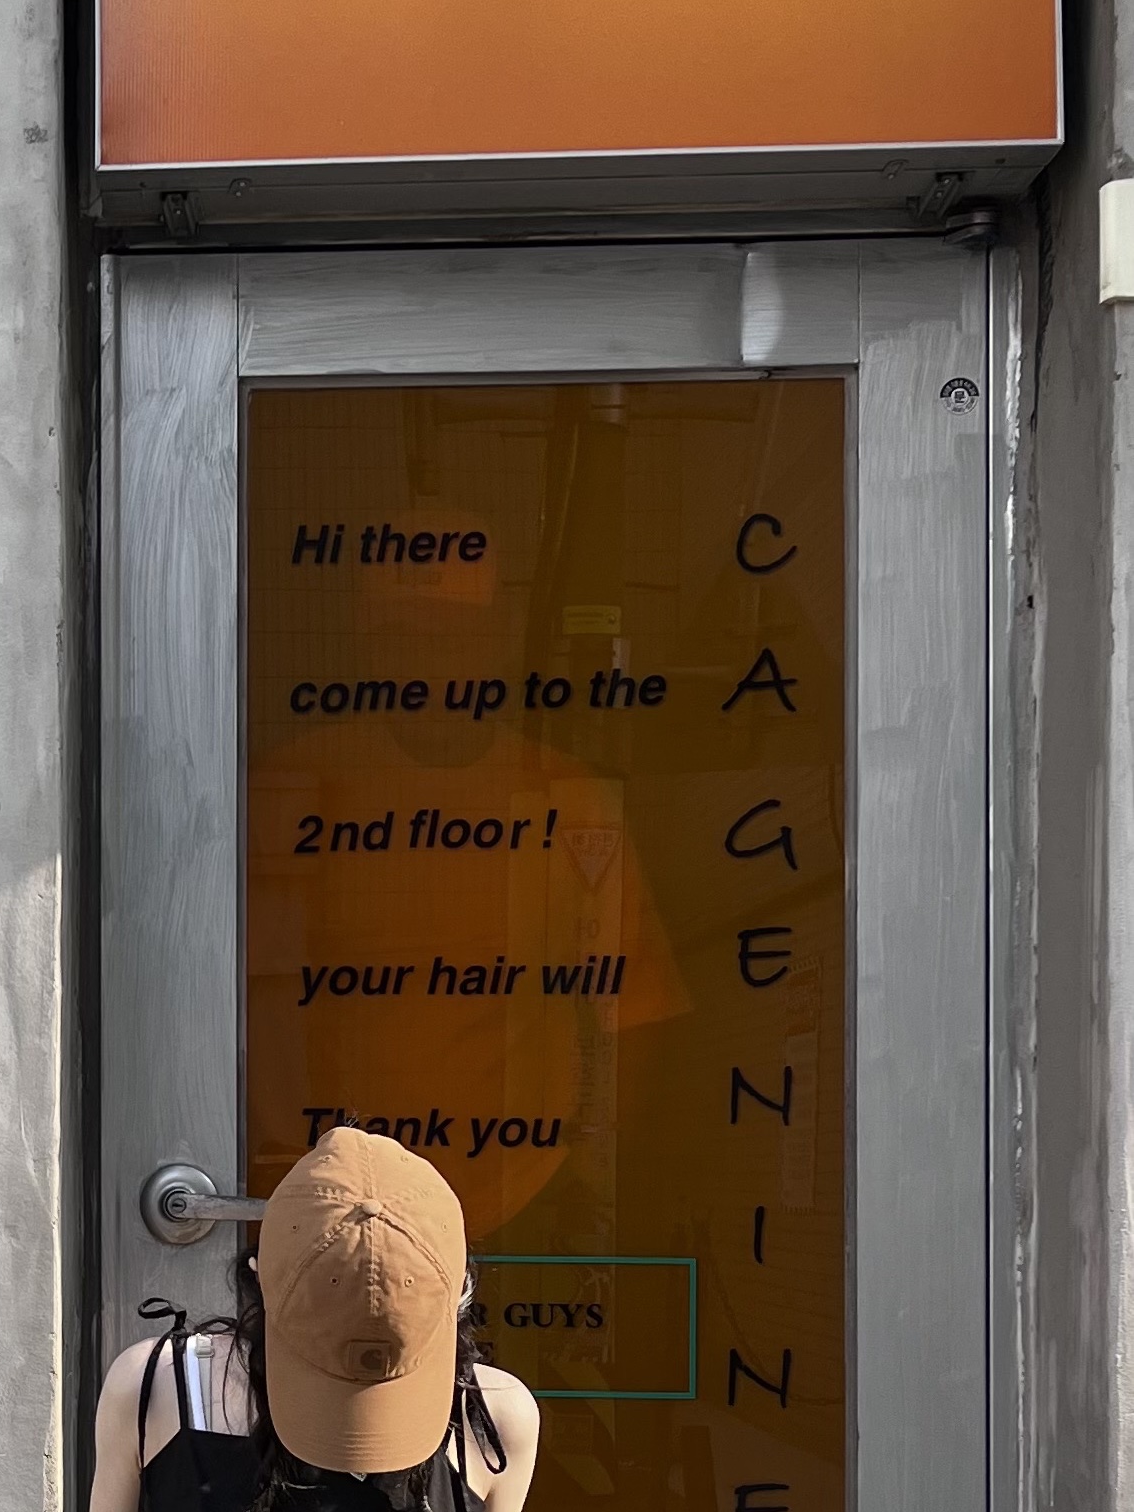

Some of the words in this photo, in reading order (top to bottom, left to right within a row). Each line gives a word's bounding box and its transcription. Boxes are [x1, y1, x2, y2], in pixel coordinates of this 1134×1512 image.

[291, 524, 345, 565] Hi
[360, 523, 487, 564] there
[289, 680, 429, 715] come
[444, 679, 507, 720] up
[524, 671, 572, 710] to
[589, 668, 667, 709] the
[293, 811, 393, 854] 2nd
[297, 965, 415, 1007] your
[427, 956, 526, 996] hair
[542, 955, 626, 995] will
[467, 1117, 561, 1158] you
[503, 1302, 604, 1329] GUYS
